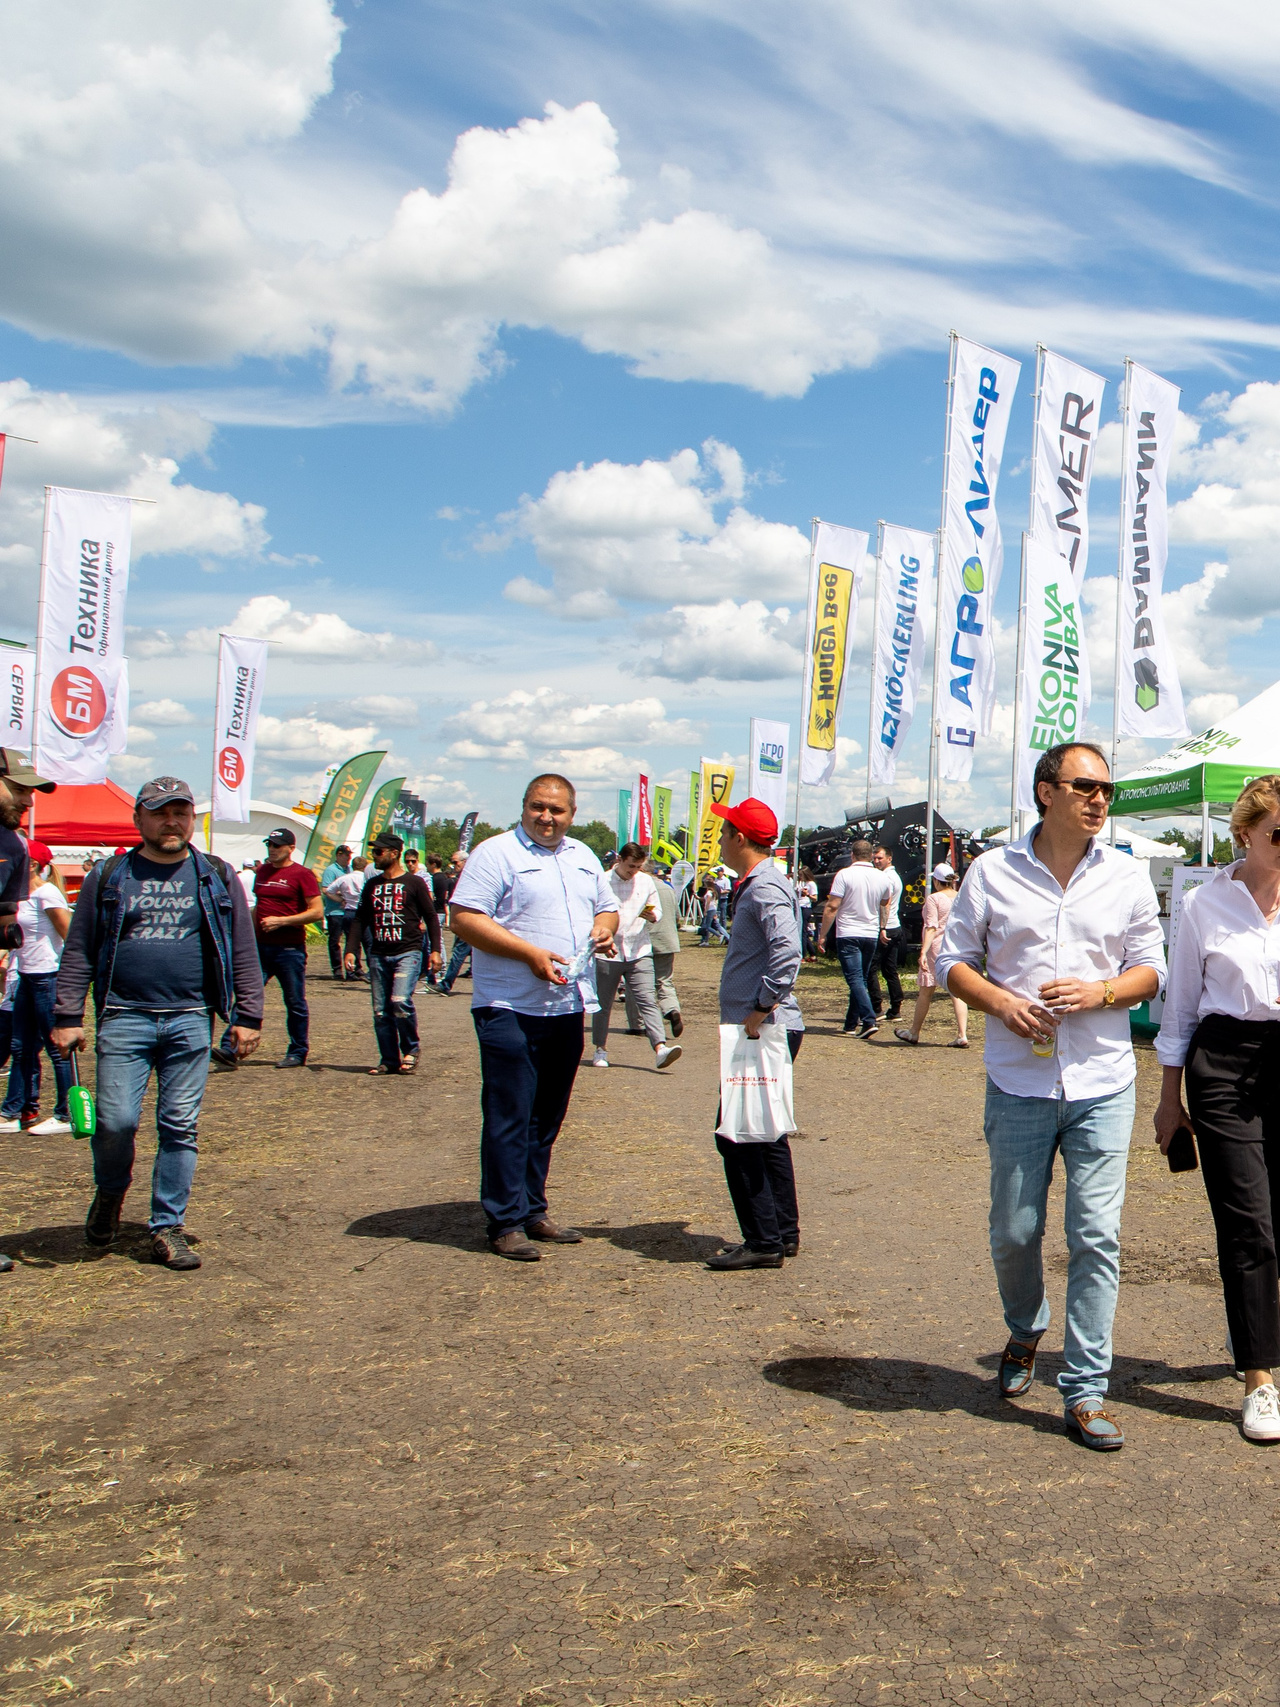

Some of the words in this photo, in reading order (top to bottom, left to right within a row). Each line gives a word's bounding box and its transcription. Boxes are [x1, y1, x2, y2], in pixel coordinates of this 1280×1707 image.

[105, 541, 115, 576] дилер
[69, 538, 101, 654] Техника
[98, 577, 113, 657] Официальный
[885, 554, 920, 713] KÖCKERLING
[1029, 582, 1063, 752] EKONIVA
[1057, 601, 1080, 744] КОНИВА
[10, 664, 24, 731] СЕРВИС
[66, 673, 93, 724] БМ
[226, 665, 250, 740] Техника
[223, 751, 239, 783] БМ
[760, 742, 784, 759] АГРО
[128, 894, 195, 913] YOUNG
[141, 880, 185, 894] STAY
[130, 926, 191, 940] CRAZY
[141, 911, 184, 925] STAY
